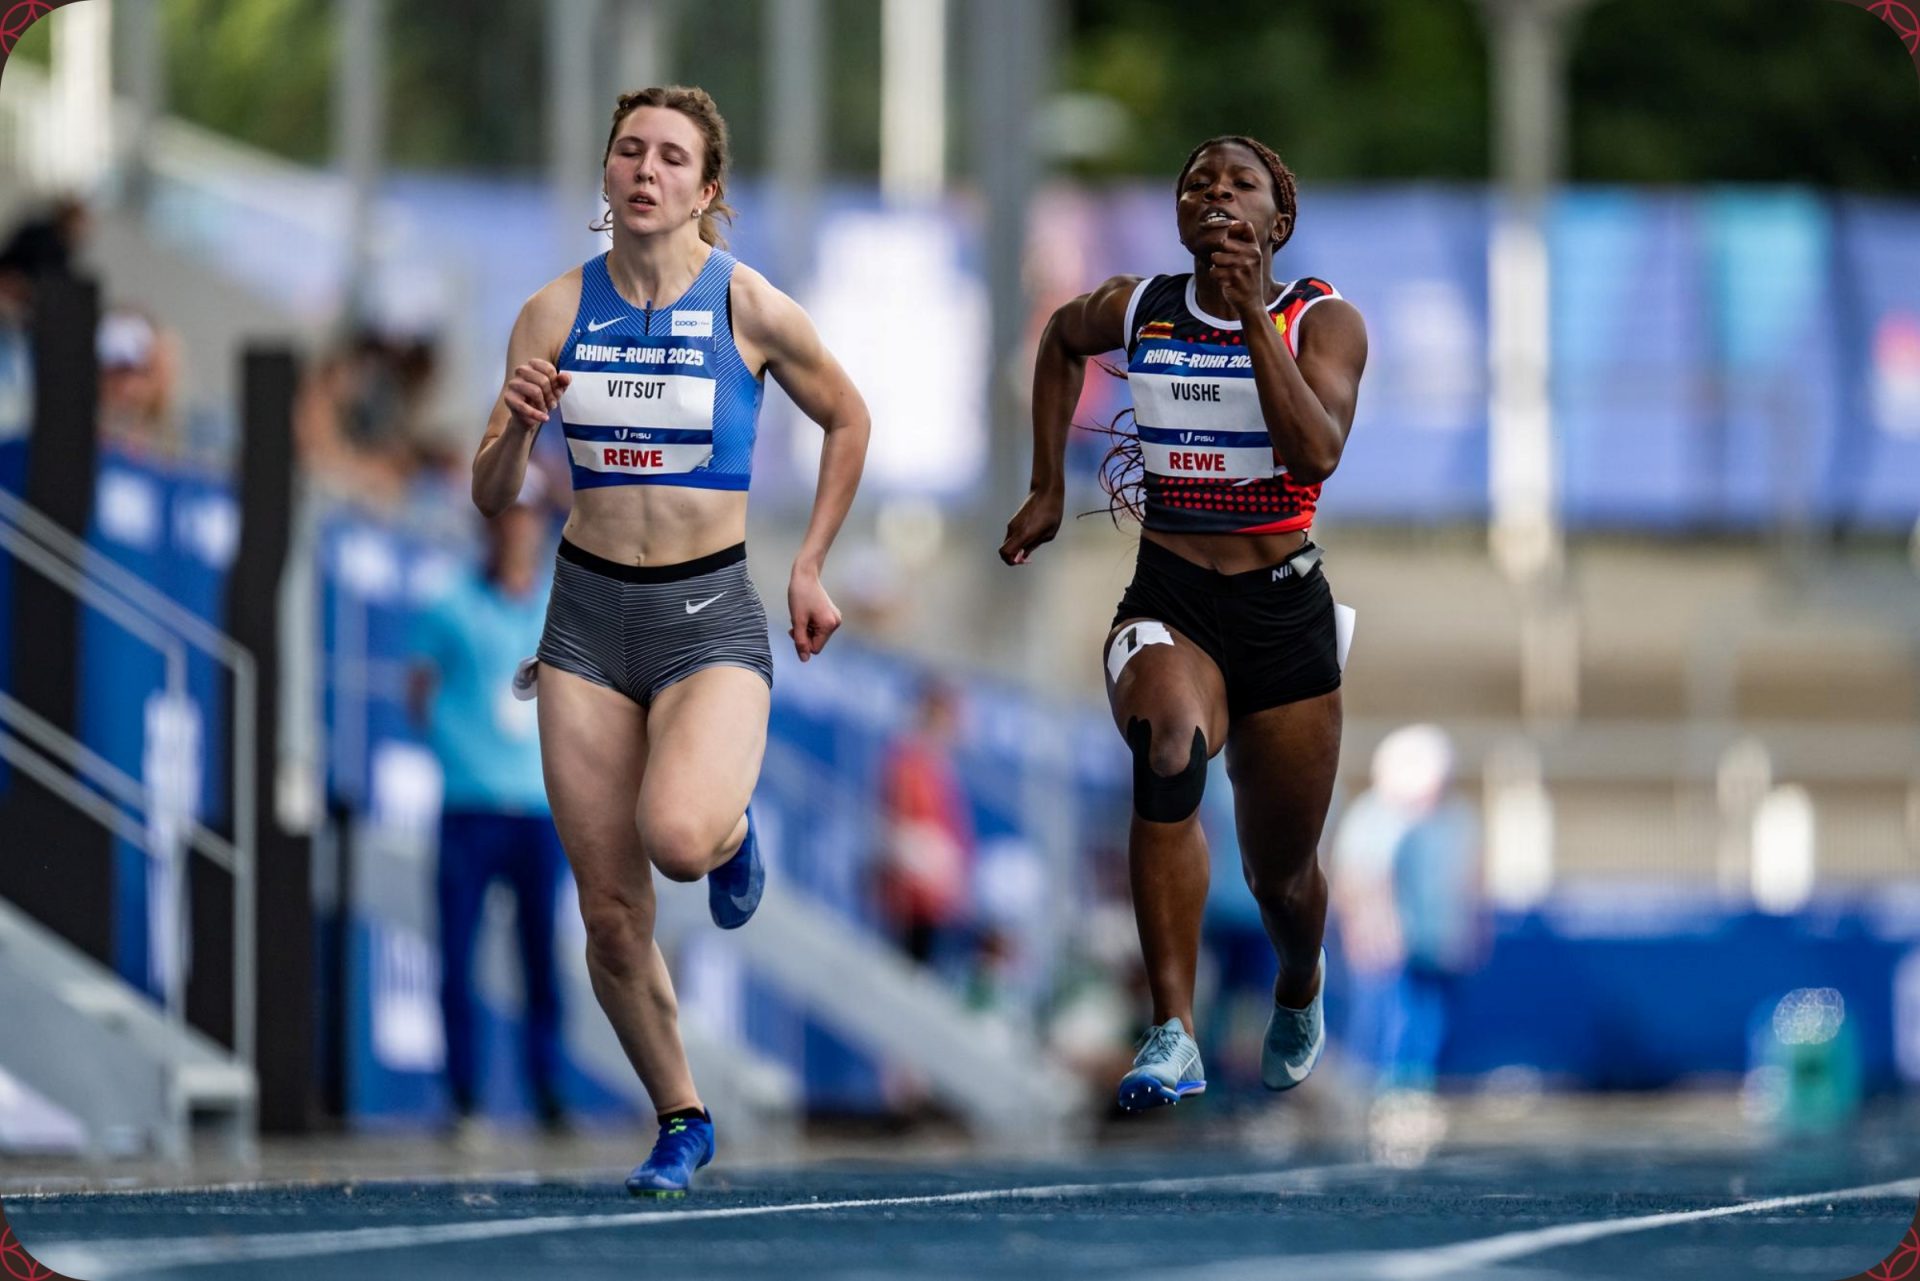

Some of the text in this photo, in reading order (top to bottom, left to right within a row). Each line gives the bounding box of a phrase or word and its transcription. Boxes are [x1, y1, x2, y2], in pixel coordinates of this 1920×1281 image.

[575, 343, 704, 366] RHINE-RUHR 2025
[1143, 349, 1252, 369] RHINE-RUHR 202
[607, 379, 666, 399] VITSUT
[1171, 382, 1221, 402] VUSHE
[630, 432, 652, 440] FISU
[603, 448, 663, 468] REWE
[1169, 451, 1226, 471] REWE
